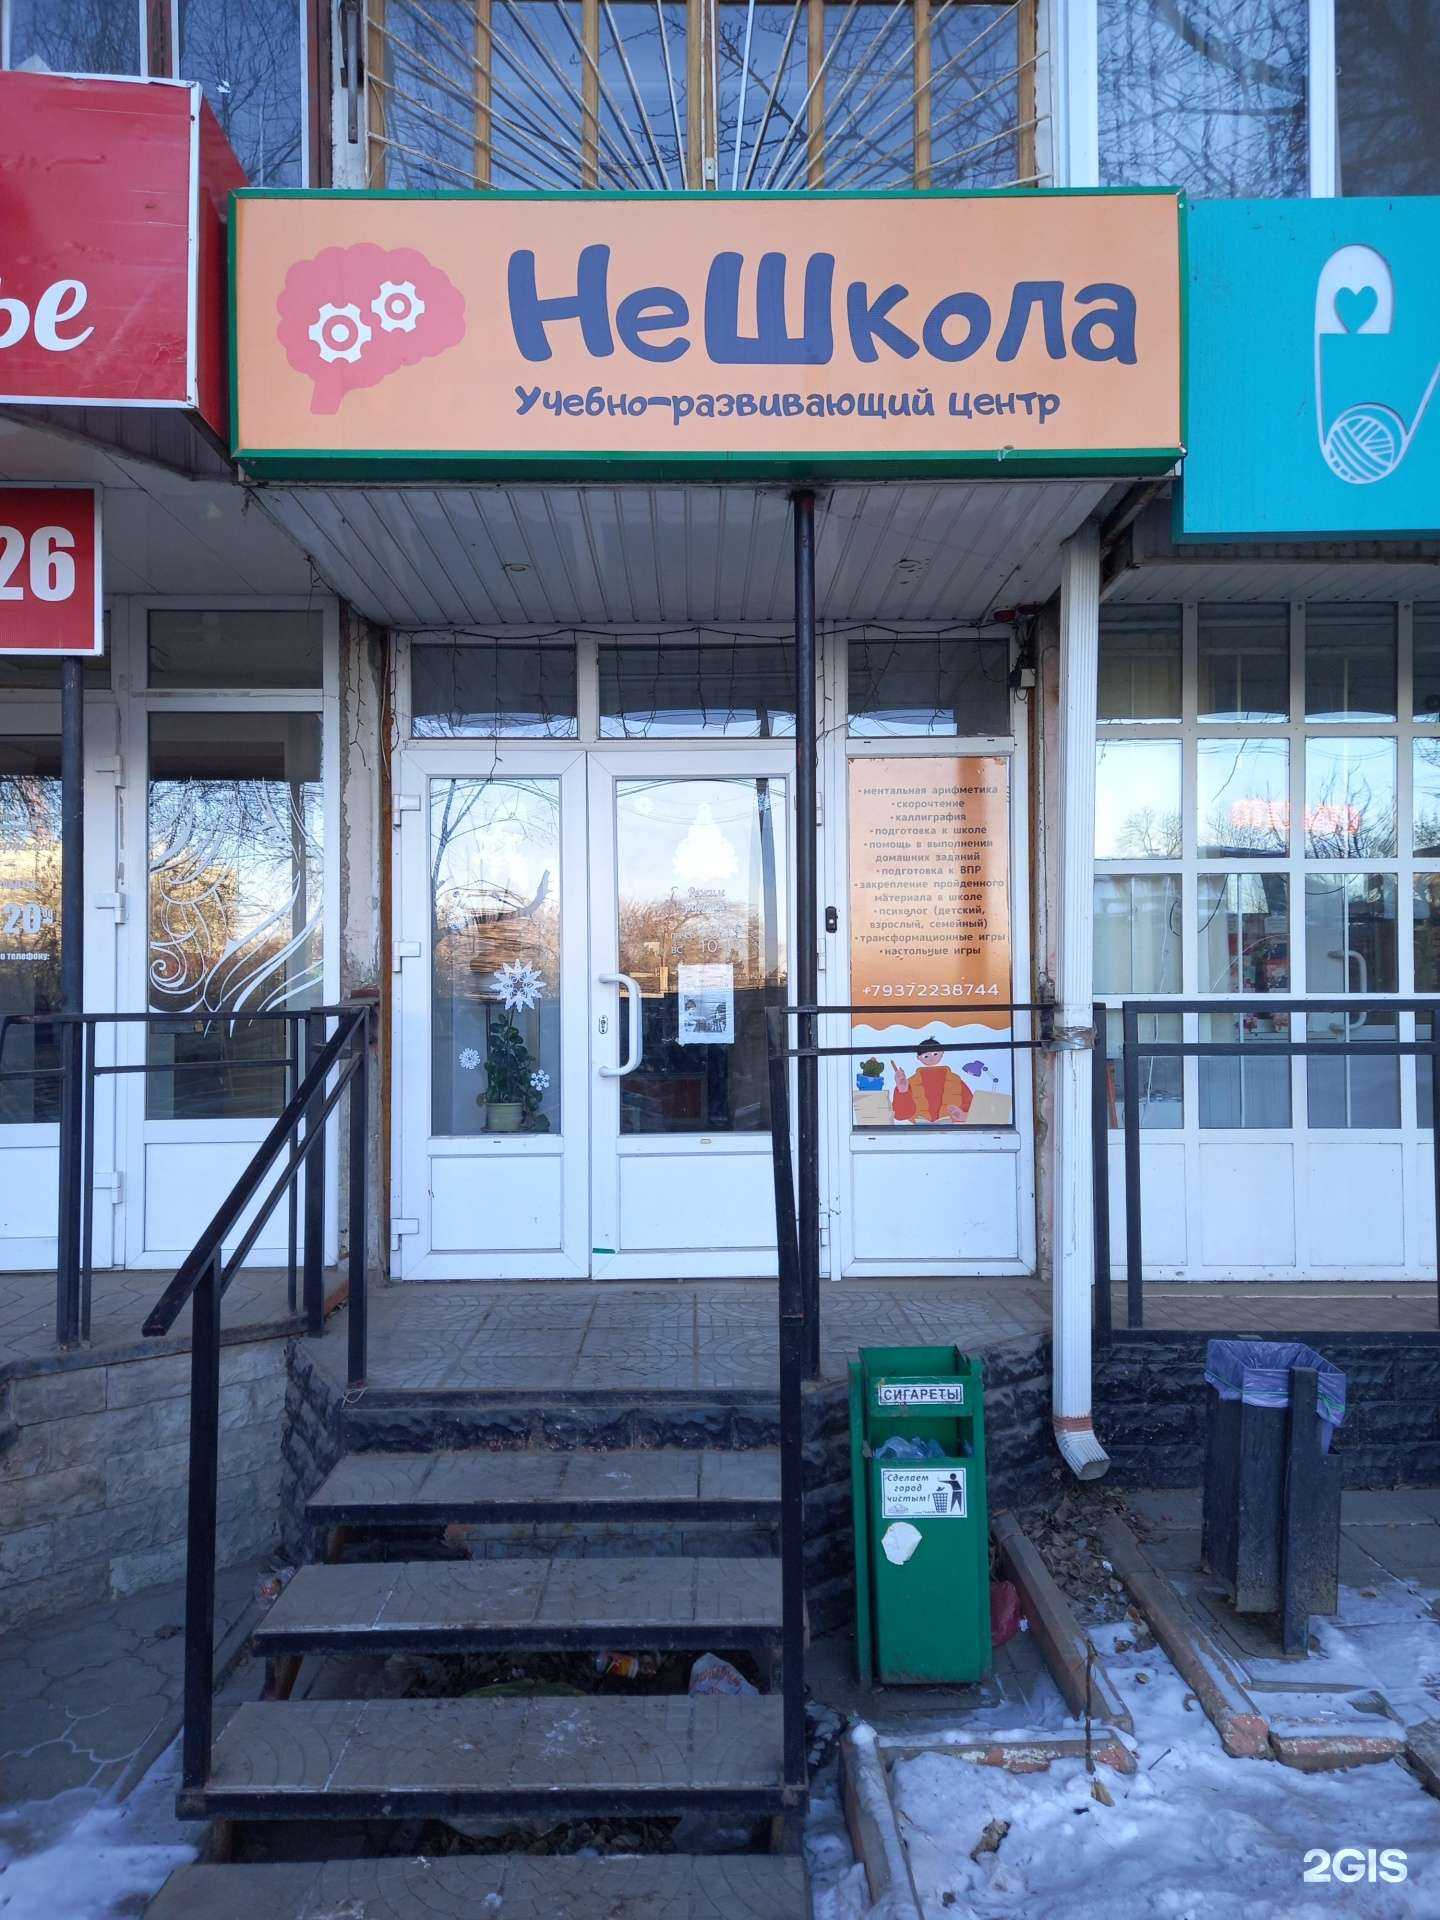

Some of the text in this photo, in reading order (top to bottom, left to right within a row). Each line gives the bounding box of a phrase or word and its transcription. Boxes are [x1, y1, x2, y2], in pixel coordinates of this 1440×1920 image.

[508, 244, 1138, 364] НеШкола
[515, 386, 1061, 425] Учебно-развивающий центр
[863, 785, 998, 796] ментальная арифметика
[896, 799, 965, 809] скорочтение
[895, 812, 967, 823] каллиграфия
[875, 827, 937, 836] подготовка
[953, 826, 987, 834] школе
[869, 840, 911, 849] помощь
[927, 840, 993, 849] выполнении
[875, 853, 981, 863] домашних заданий
[881, 867, 943, 876] подготовка
[960, 865, 981, 875] ВПР
[860, 879, 1004, 889] закрепление пройденного
[874, 893, 932, 902] материала
[949, 893, 983, 901] школе
[879, 905, 985, 916] психолог (детский,
[870, 918, 988, 929] взрослый, семейный)
[860, 933, 1006, 944] трансформационные игры
[884, 946, 981, 956] настольные игры
[863, 983, 1001, 997] +79372238744
[883, 1387, 960, 1401] СИГАРЕТЫ
[886, 1473, 929, 1482] Сделаем
[893, 1484, 923, 1494] город
[886, 1494, 931, 1503] чистым!
